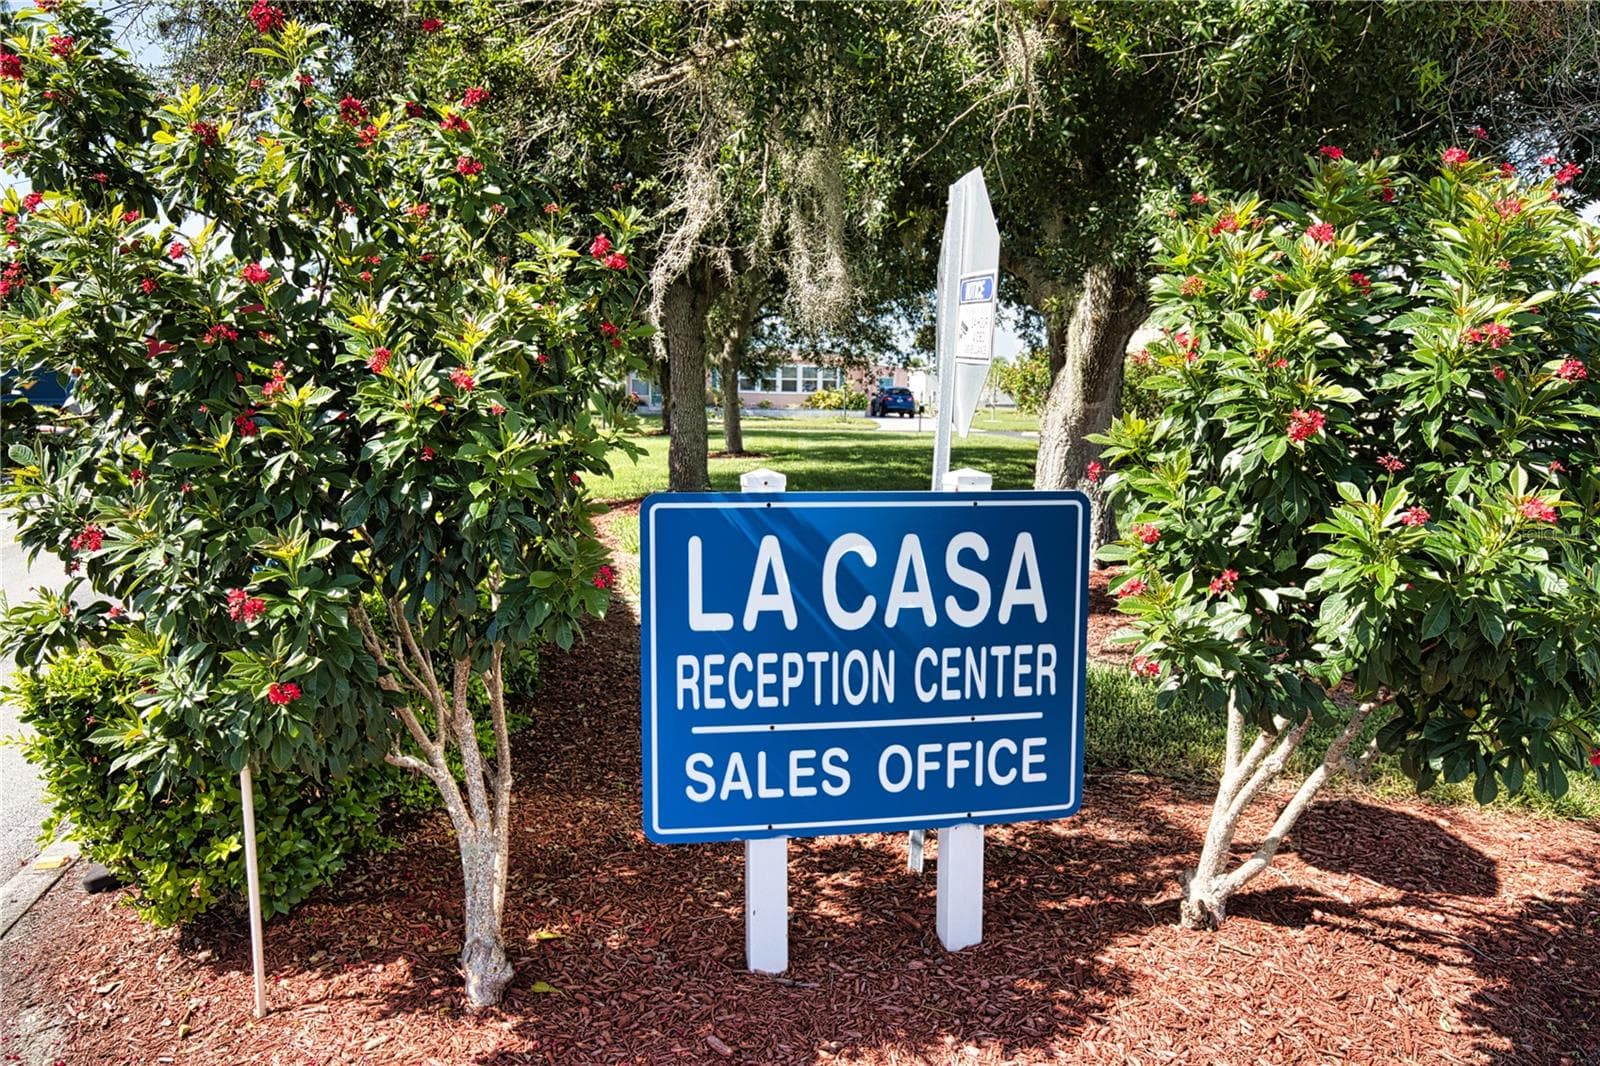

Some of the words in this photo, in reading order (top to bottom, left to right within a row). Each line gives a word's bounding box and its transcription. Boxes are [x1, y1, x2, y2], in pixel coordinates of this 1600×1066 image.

[687, 534, 799, 632] LA
[821, 531, 1048, 631] CASA
[676, 648, 896, 711] RECEPTION
[914, 643, 1058, 704] CENTER
[685, 746, 852, 803] SALES
[877, 736, 1048, 794] OFFICE
